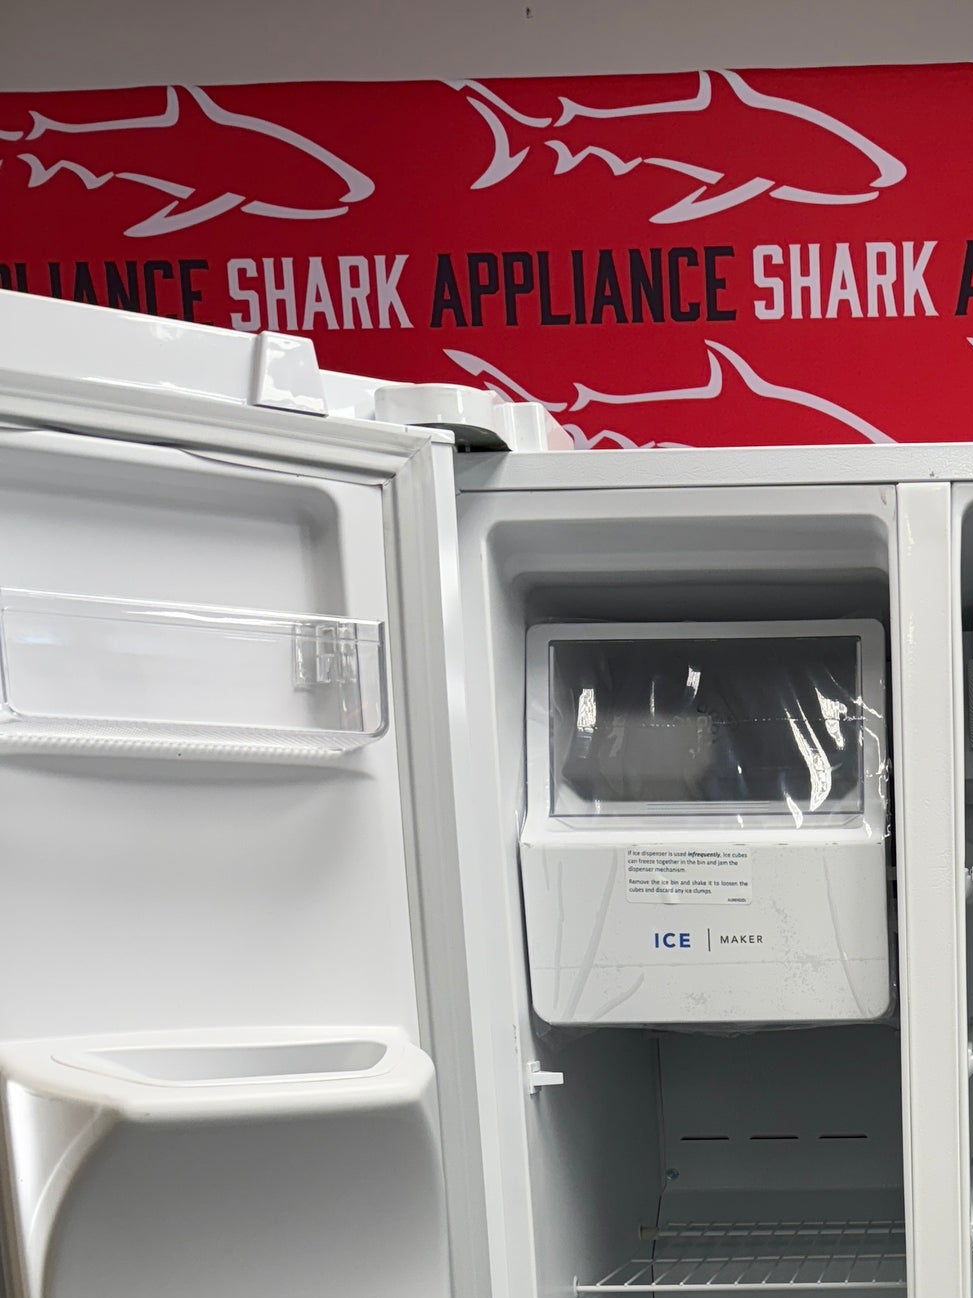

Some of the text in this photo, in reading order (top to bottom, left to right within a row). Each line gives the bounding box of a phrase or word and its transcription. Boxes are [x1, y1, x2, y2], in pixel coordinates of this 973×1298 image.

[228, 253, 413, 331] SHARK
[430, 245, 737, 328] APPLIANCE
[752, 241, 938, 320] SHARK
[654, 932, 764, 948] ICE MAKER
